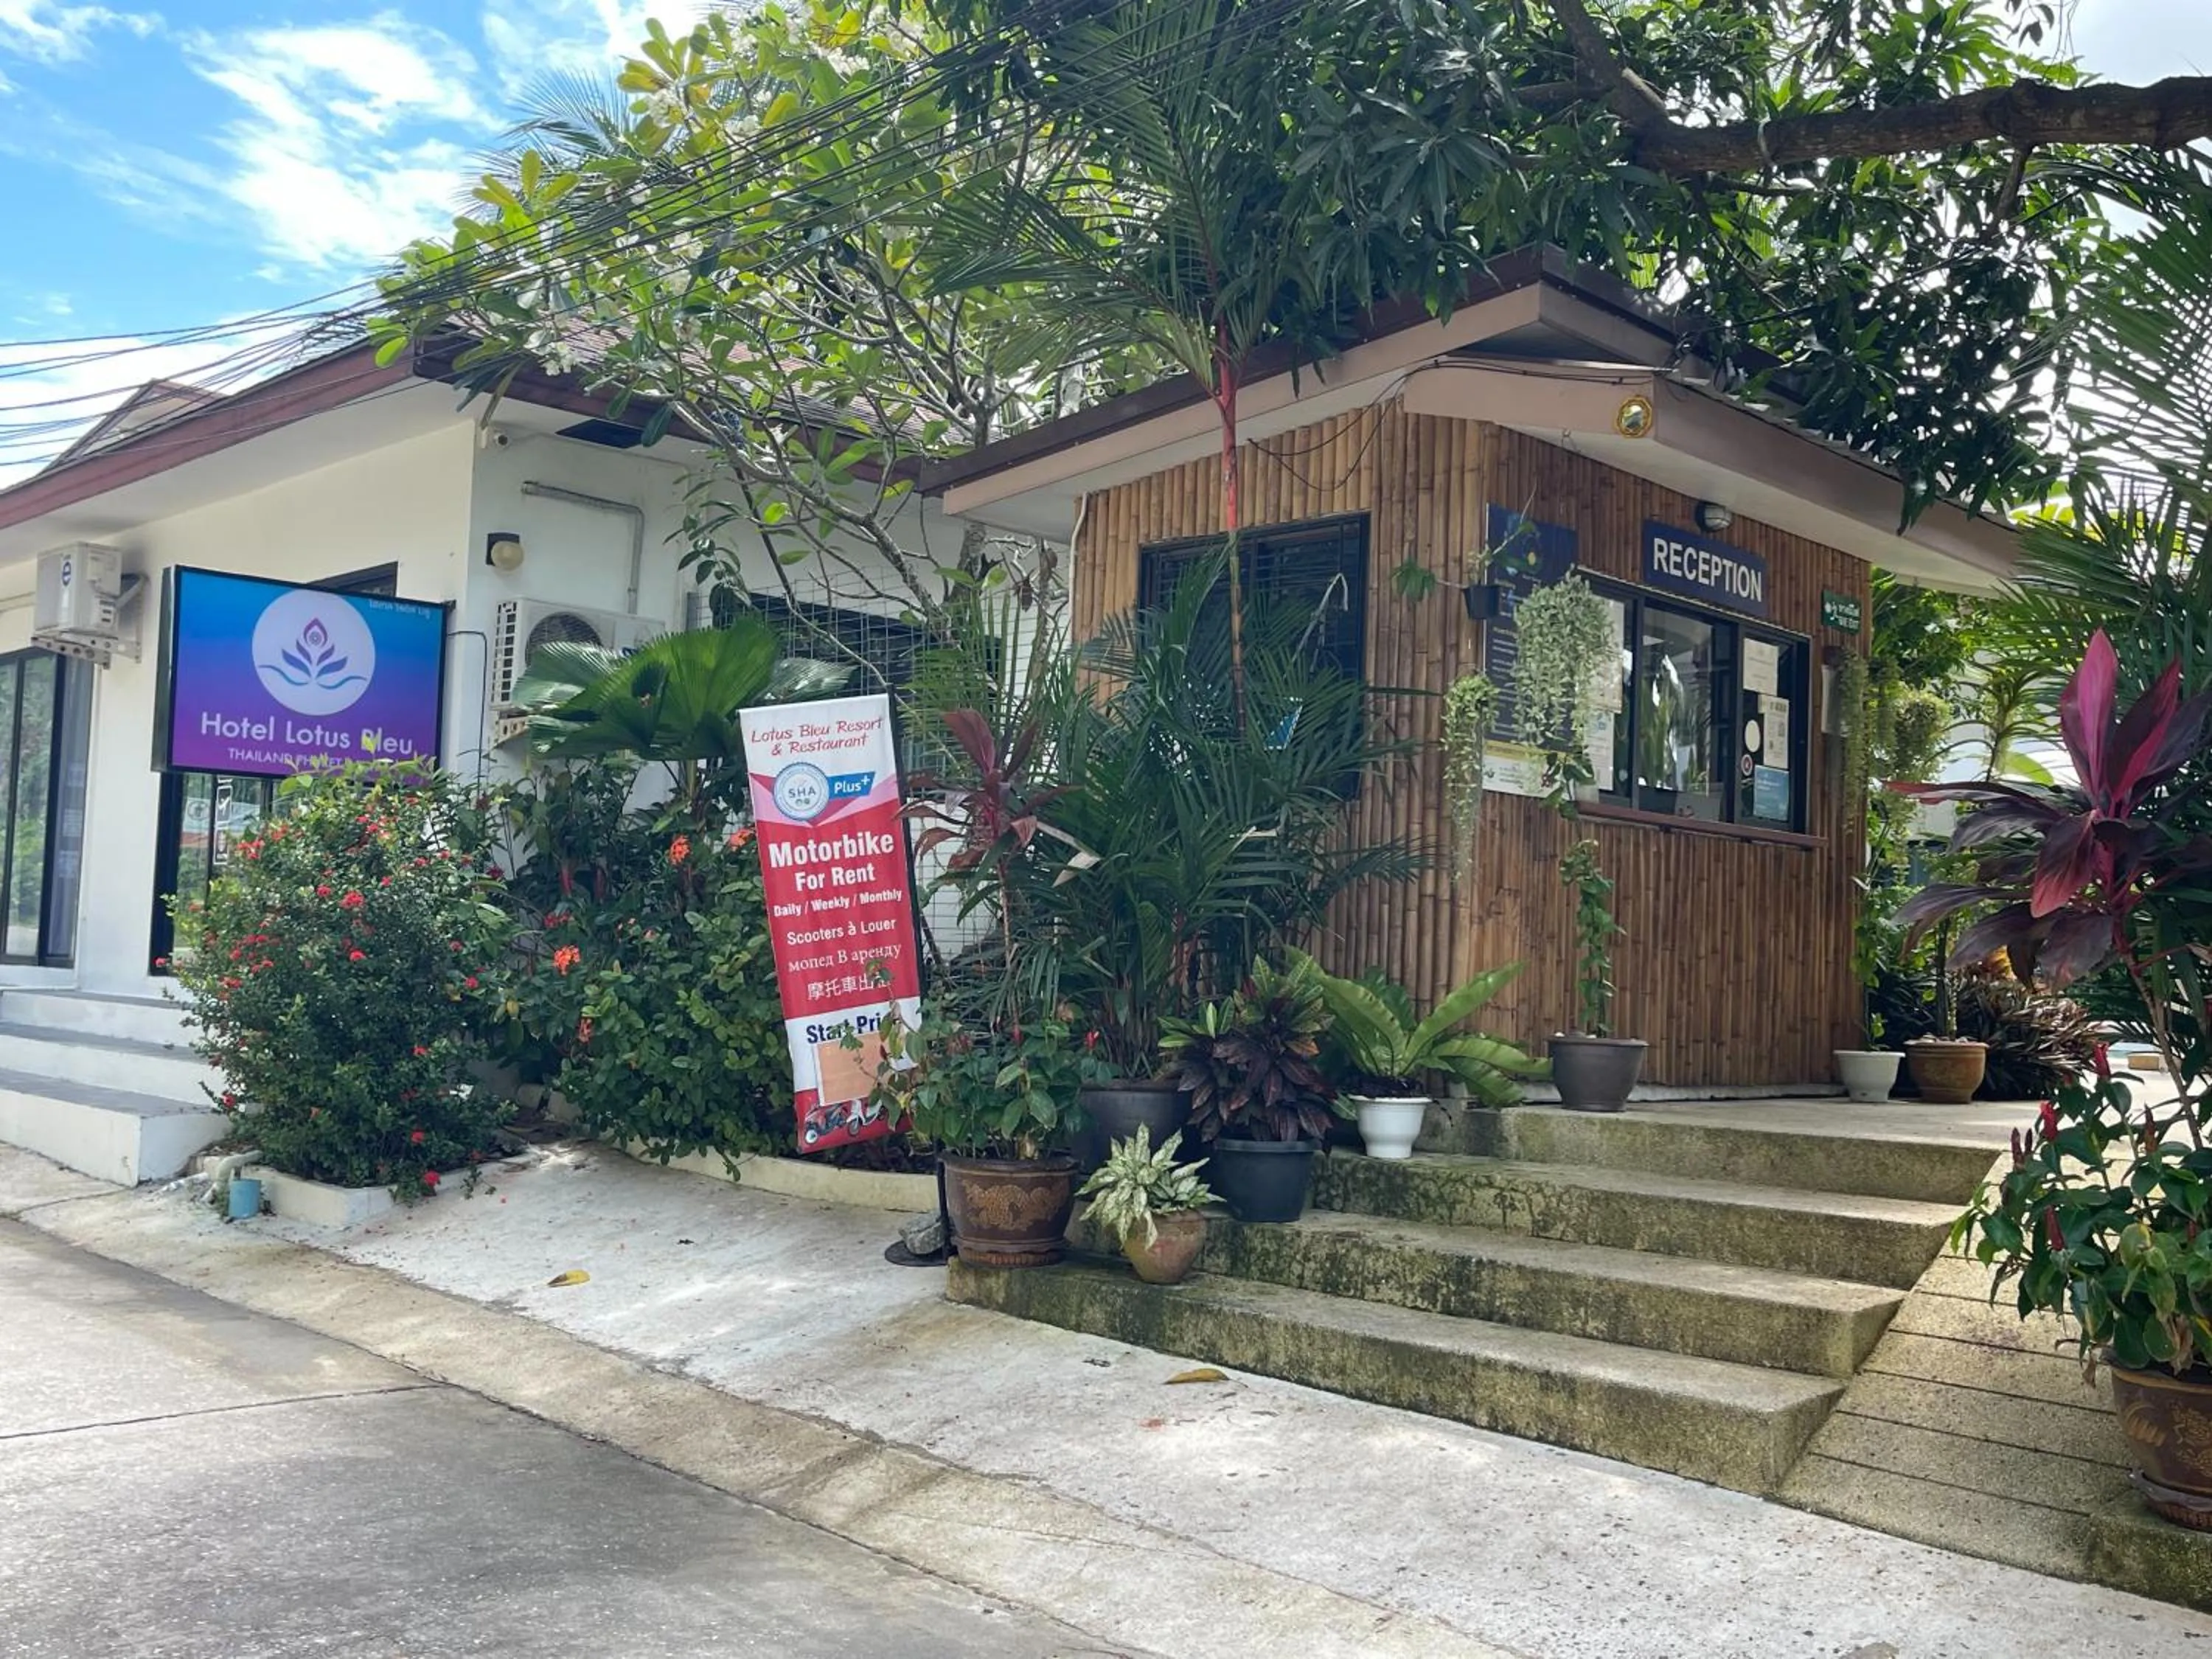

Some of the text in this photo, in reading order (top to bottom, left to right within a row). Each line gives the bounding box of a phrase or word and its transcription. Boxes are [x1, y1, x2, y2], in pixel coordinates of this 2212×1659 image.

[1653, 538, 1762, 602] RECEPTION
[201, 712, 412, 754] Hotel Lotus Bleu
[751, 717, 884, 743] Lotus Bleu Resort
[228, 747, 293, 764] THAILAND
[296, 753, 343, 768] PHET
[771, 734, 869, 757] & Restaurant
[788, 786, 816, 799] SHA
[768, 831, 894, 869] Motorbike
[796, 863, 876, 891] For Rent
[773, 888, 902, 917] Daily / Weekly / Monthly
[787, 919, 897, 945] Scooters à Louer
[788, 953, 834, 973] мопед
[852, 944, 902, 965] аренду
[856, 1012, 881, 1034] Pri
